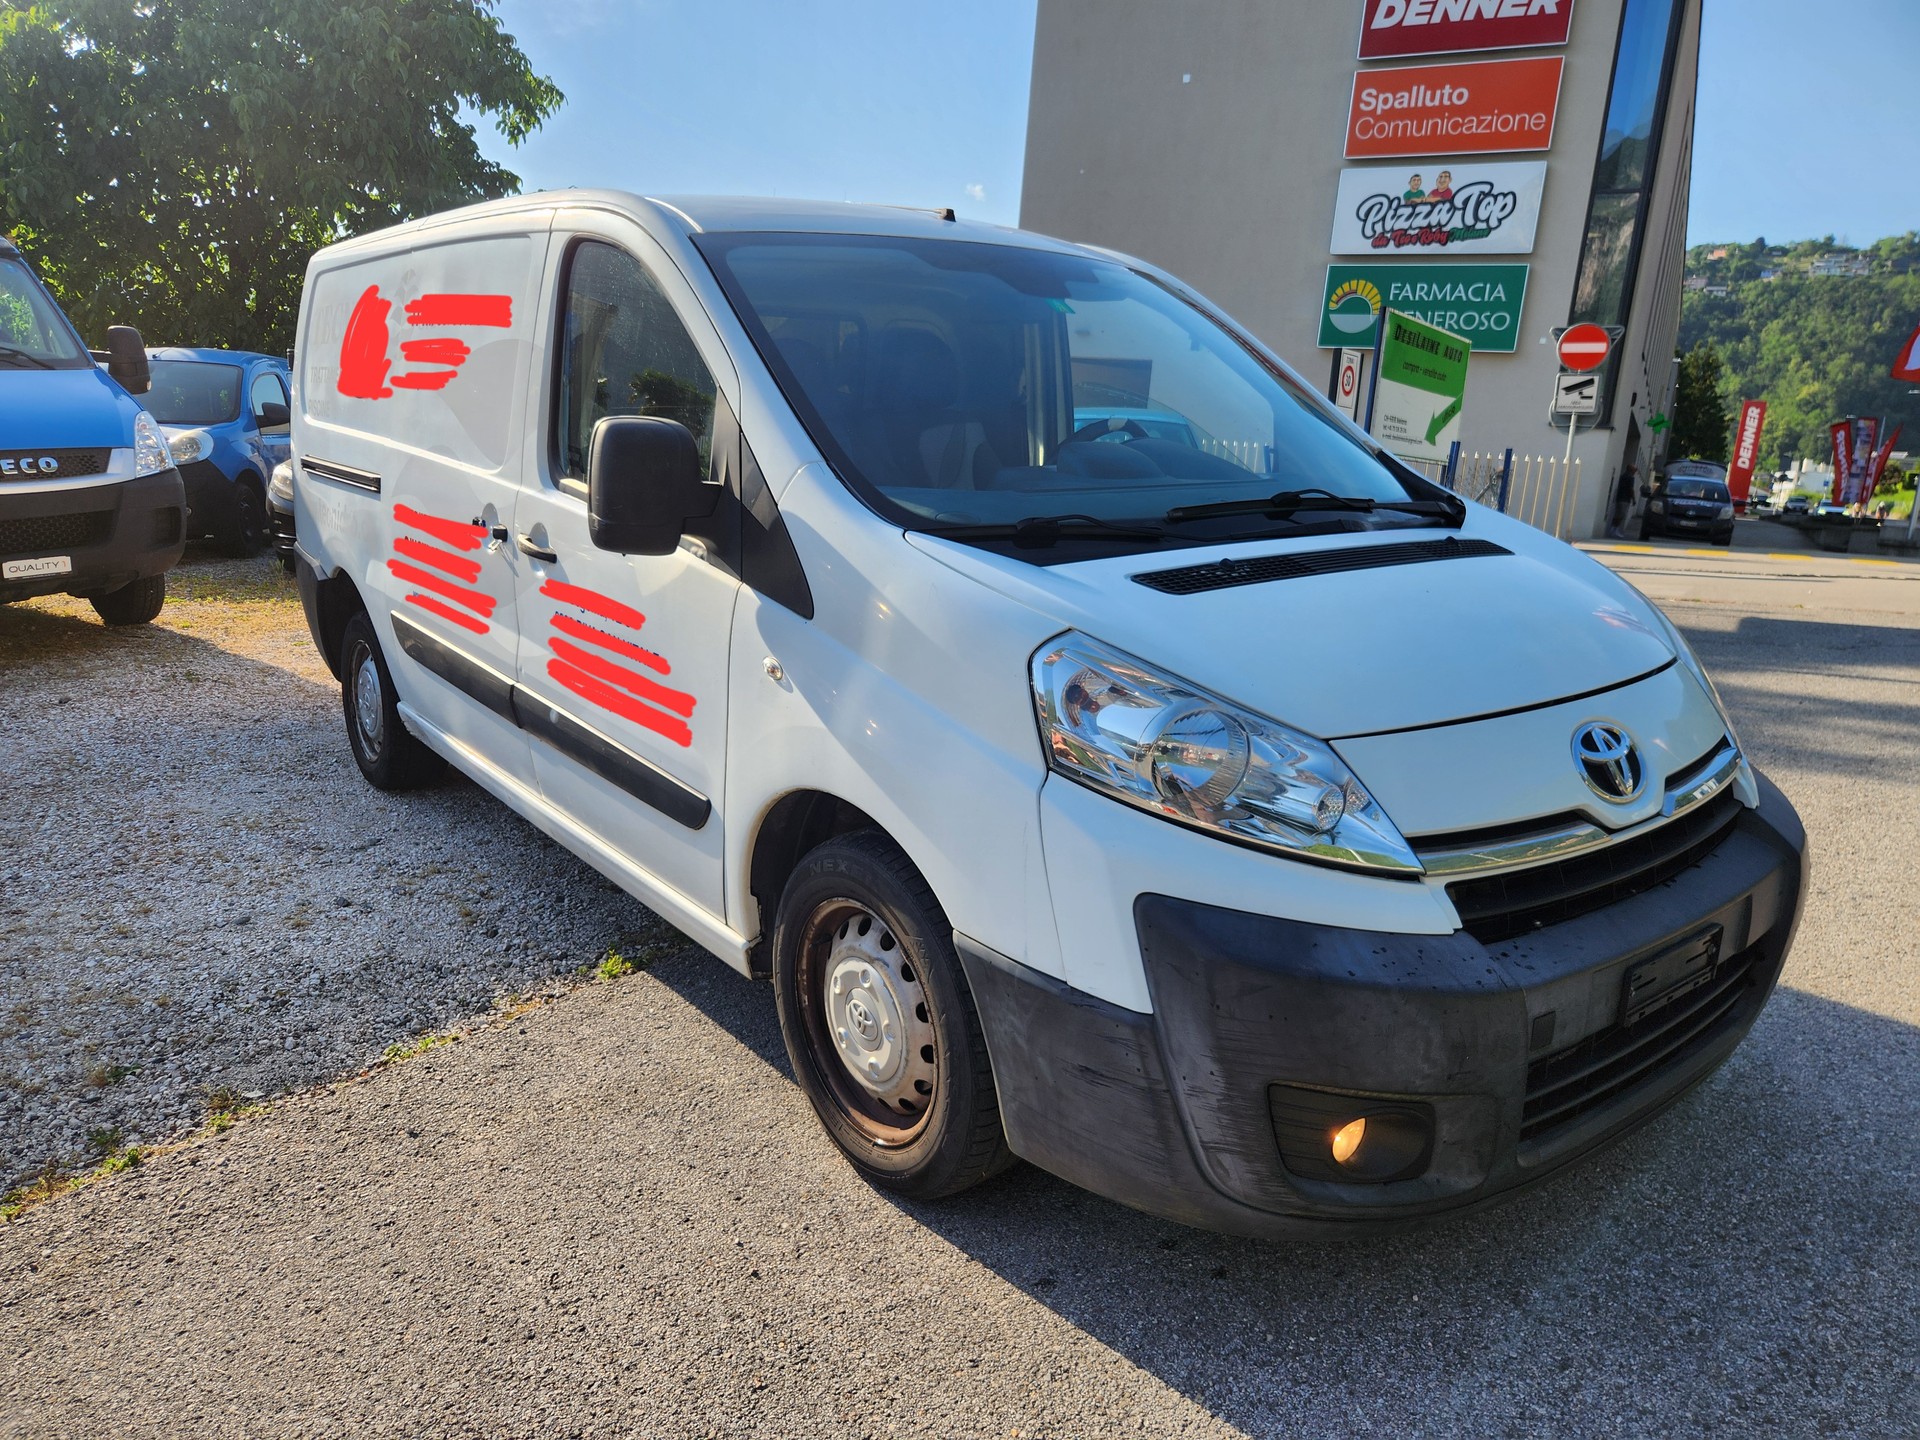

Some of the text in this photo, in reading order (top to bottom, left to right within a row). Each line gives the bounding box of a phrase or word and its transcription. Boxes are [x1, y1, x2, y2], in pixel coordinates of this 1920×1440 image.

[1370, 0, 1560, 29] DENNER
[1359, 84, 1469, 115] Spalluto
[1355, 109, 1547, 140] Comunicazione
[1389, 282, 1506, 302] FARMACIA
[1737, 406, 1761, 470] DENNER
[9, 561, 59, 573] QUALITY
